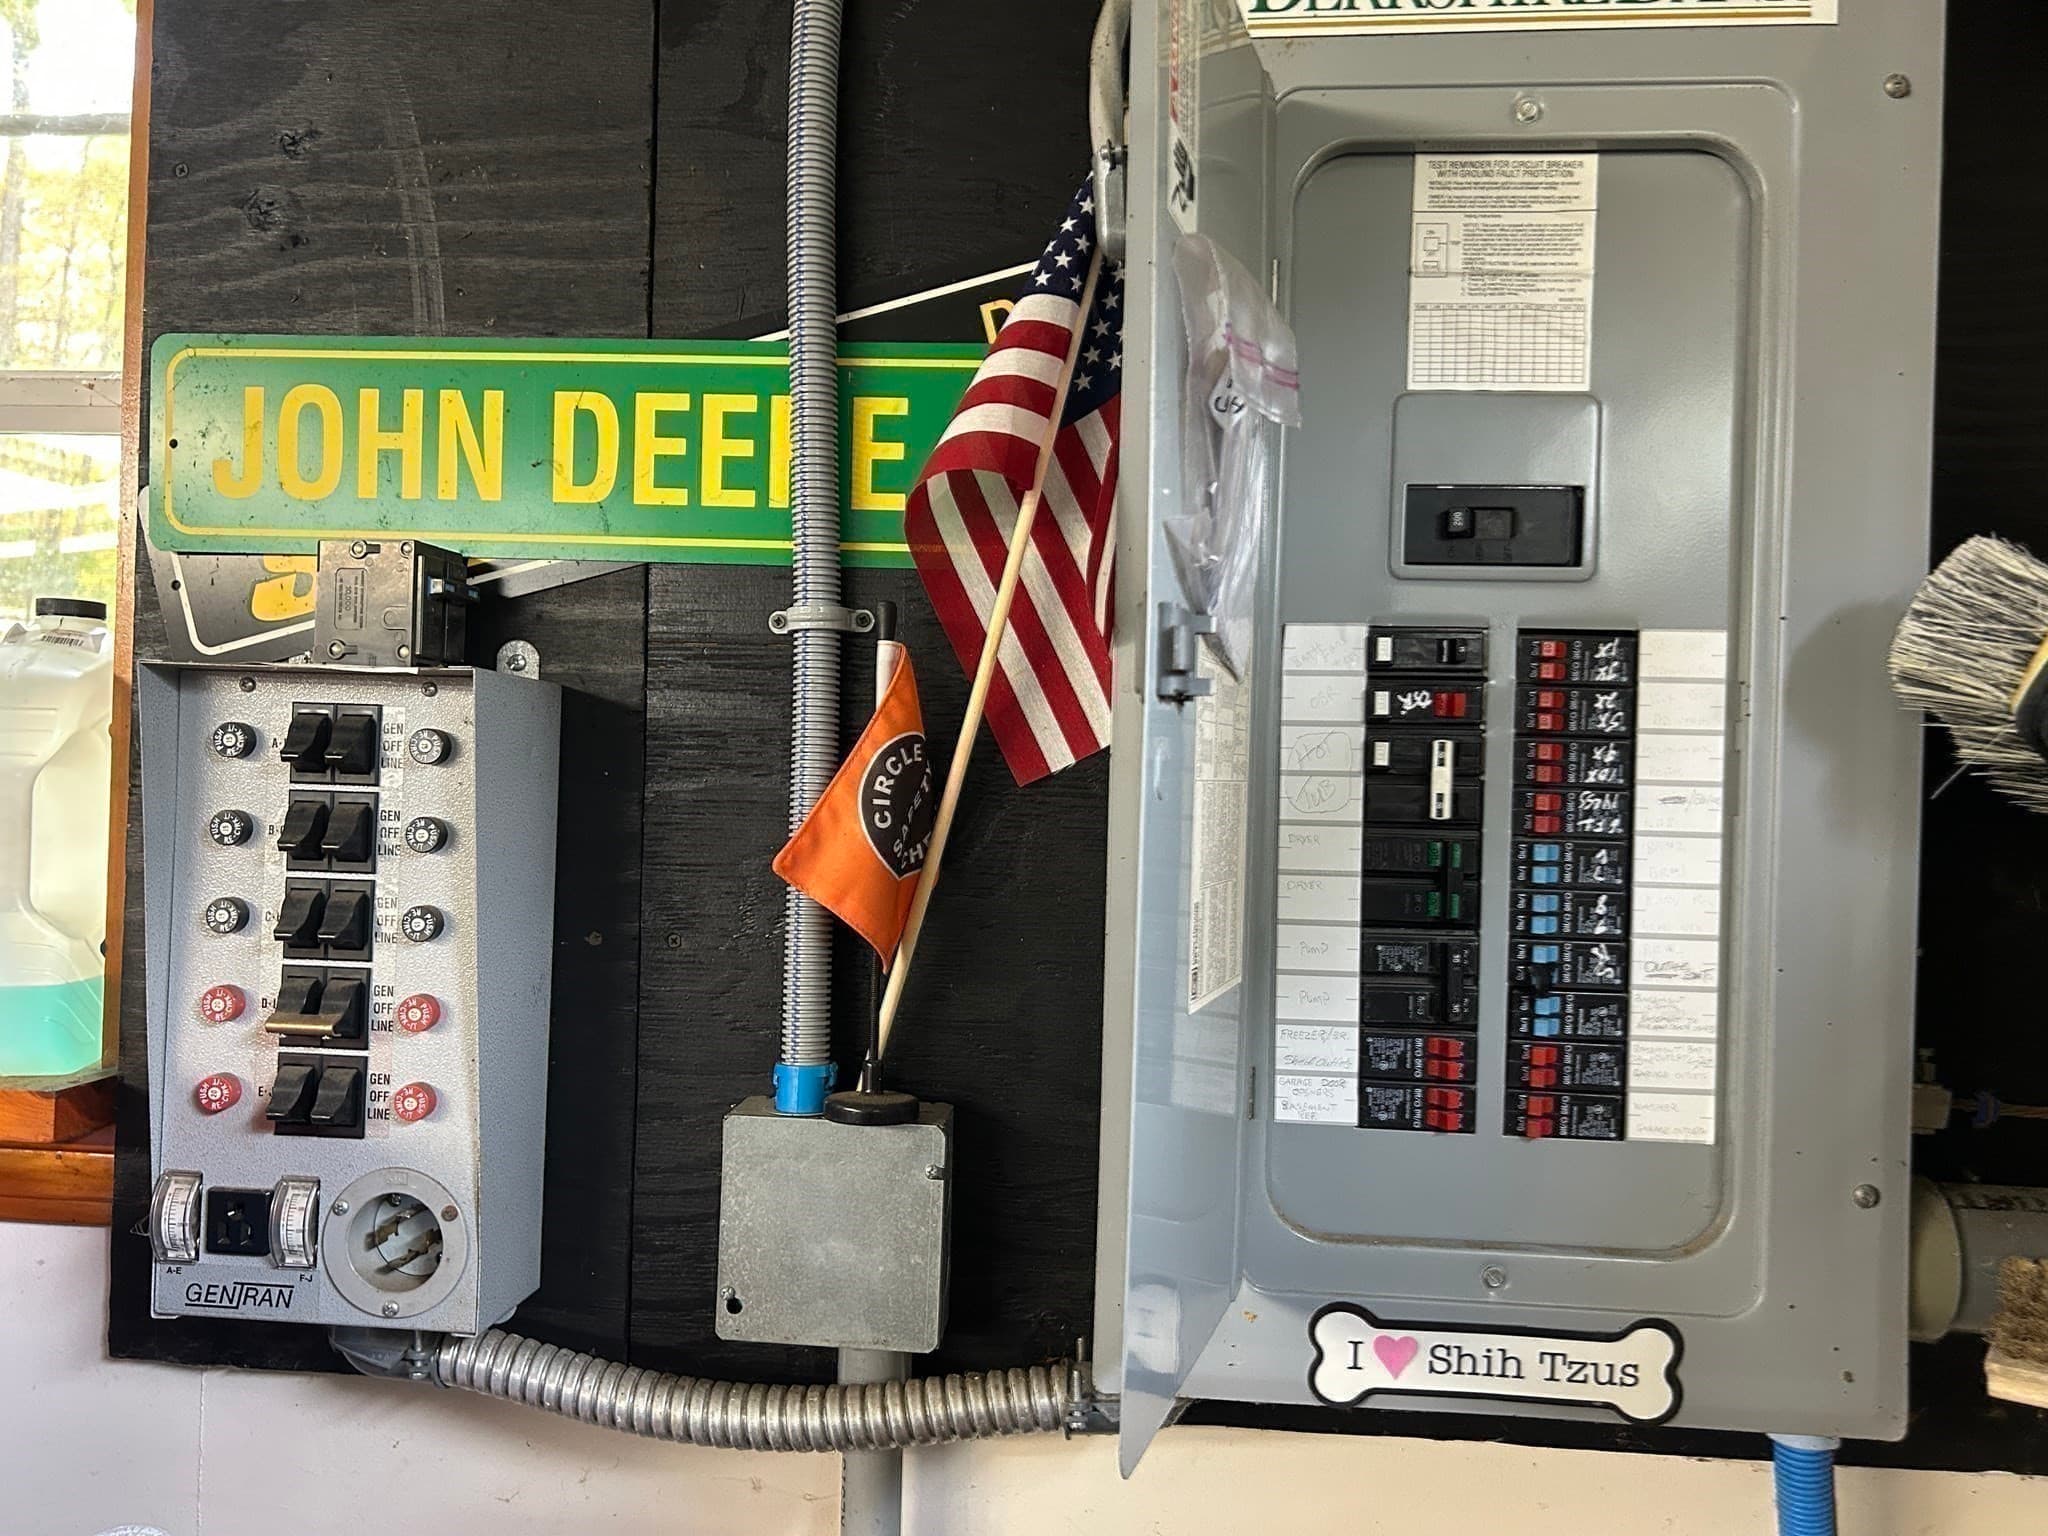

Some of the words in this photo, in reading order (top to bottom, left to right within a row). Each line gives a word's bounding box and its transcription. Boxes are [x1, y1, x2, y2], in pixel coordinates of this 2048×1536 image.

[1428, 160, 1447, 169] TEST
[1449, 160, 1491, 169] REMINDER
[1494, 160, 1511, 169] FOR
[1512, 160, 1544, 169] CIRCUIT
[1546, 160, 1584, 169] BREAKER
[1437, 170, 1458, 178] WITH
[1459, 170, 1494, 178] GROUND
[1496, 170, 1520, 178] FAULT
[1522, 170, 1574, 178] PROTECTION
[212, 384, 504, 501] JOHN
[384, 723, 403, 734] GEN
[214, 729, 224, 750] PUSH
[432, 735, 440, 756] PUSH
[383, 741, 402, 752] OFF
[381, 757, 403, 768] LINE
[873, 744, 922, 829] CIRCLE
[380, 810, 400, 821] GEN
[211, 816, 220, 839] PUSH
[380, 827, 400, 838] OFF
[428, 824, 437, 846] PUSH
[378, 845, 400, 856] LINE
[378, 897, 398, 908] GEN
[208, 905, 216, 927] PUSH
[377, 915, 396, 926] OFF
[424, 914, 433, 935] PUSH
[375, 932, 398, 943] LINE
[374, 985, 394, 996] GEN
[203, 994, 213, 1016] PUSH
[374, 1002, 392, 1014] OFF
[420, 1003, 430, 1025] PUSH
[371, 1020, 394, 1032] LINE
[370, 1073, 390, 1084] GEN
[200, 1082, 210, 1104] PUSH
[370, 1090, 389, 1102] OFF
[416, 1092, 426, 1114] PUSH
[368, 1108, 390, 1120] LINE
[166, 1266, 182, 1274] A-E
[300, 1274, 312, 1282] F-J
[185, 1282, 294, 1309] GENTRAN
[1347, 1341, 1364, 1370] I
[1428, 1344, 1524, 1379] Shih
[1539, 1352, 1640, 1387] Tzus
